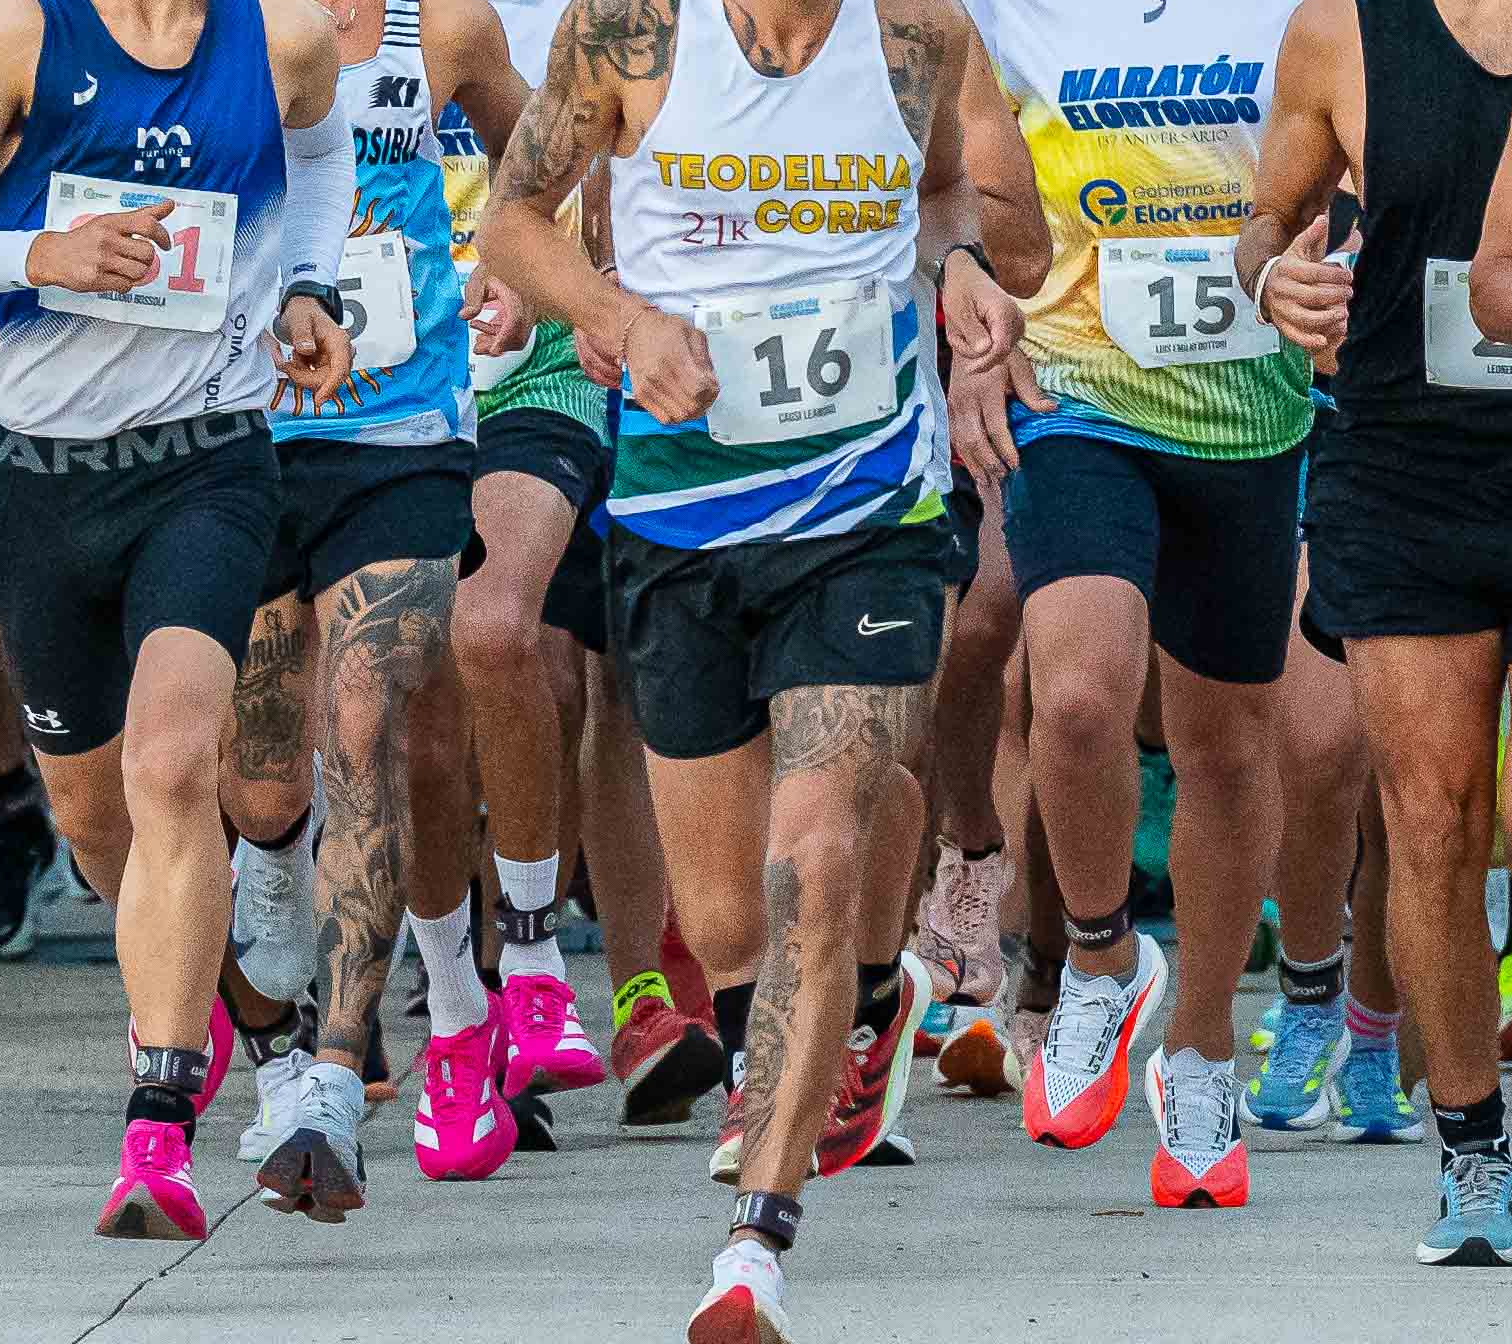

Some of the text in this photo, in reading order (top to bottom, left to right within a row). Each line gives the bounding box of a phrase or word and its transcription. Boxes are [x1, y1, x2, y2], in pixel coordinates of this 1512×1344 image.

[1059, 55, 1265, 103] MARATÓN
[1061, 96, 1262, 131] ELORTONDO
[1122, 128, 1231, 146] ANIVERSARIO
[652, 151, 911, 192] TEODELINA
[1133, 180, 1241, 199] Gobierno de
[1148, 275, 1236, 338] 15
[754, 327, 852, 407] 16
